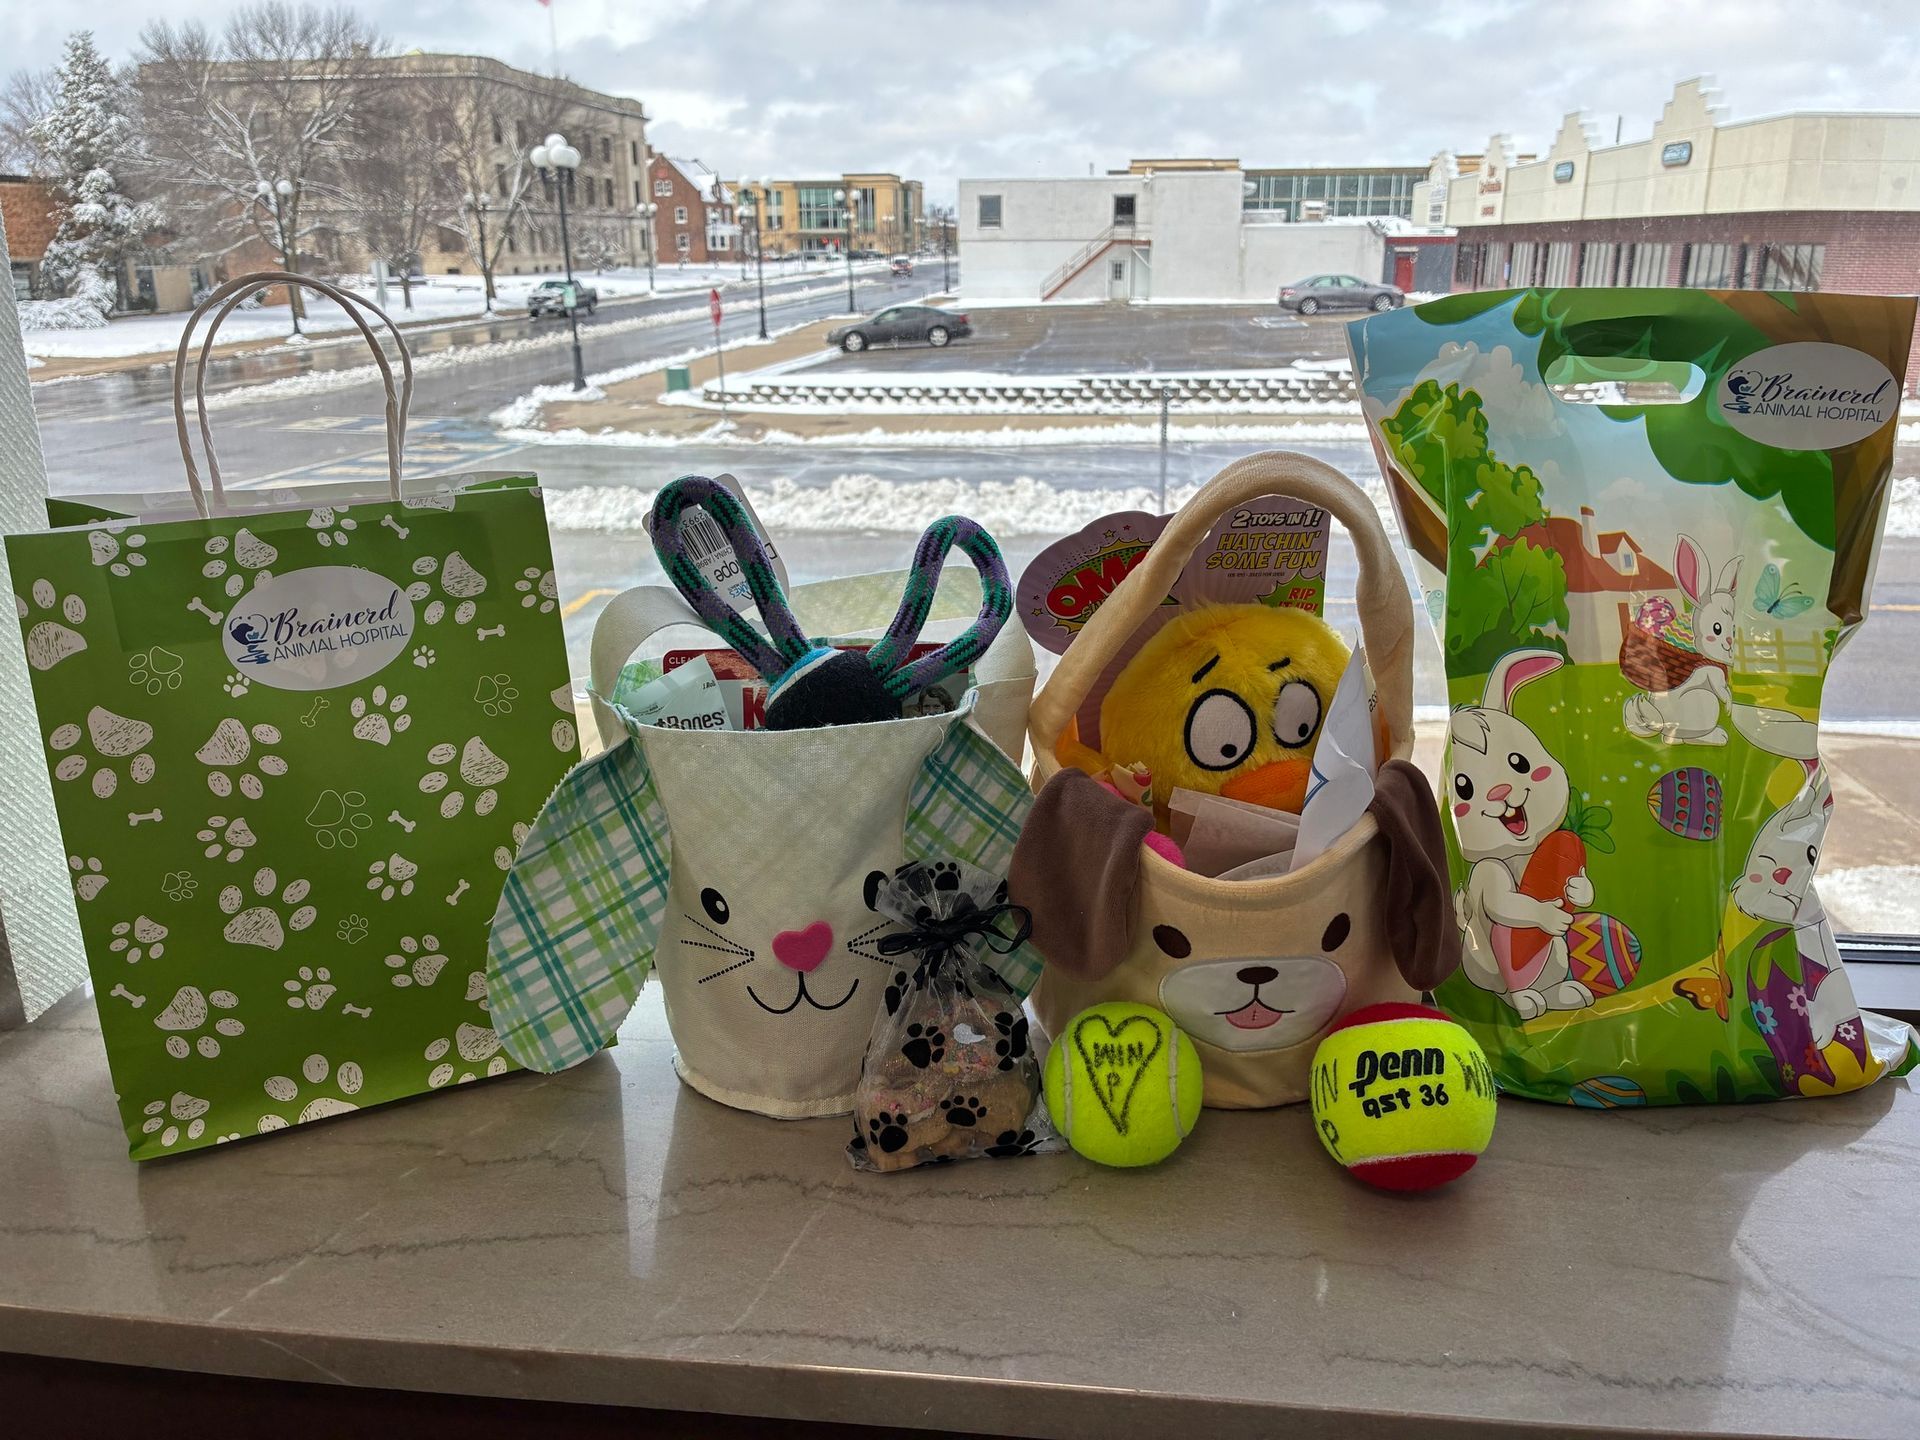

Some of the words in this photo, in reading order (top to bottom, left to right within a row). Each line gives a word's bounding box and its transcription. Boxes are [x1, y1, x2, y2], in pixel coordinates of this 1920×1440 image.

[1761, 373, 1892, 406] Brainerd
[1753, 402, 1813, 418] ANIMAL
[1817, 406, 1883, 423] HOSPITAL
[1231, 509, 1252, 529] 2
[1250, 512, 1286, 527] TOYS
[1286, 511, 1303, 526] IN
[1303, 508, 1323, 528] 1!
[1217, 530, 1323, 551] HATCHIN'
[1206, 551, 1272, 570] SOME
[1274, 550, 1321, 570] FUN
[1288, 587, 1316, 600] RIP
[270, 589, 399, 646] Brainerd
[273, 637, 338, 661] ANIMAL
[340, 623, 408, 649] HOSPITAL
[1093, 1041, 1144, 1068] WIN
[1106, 1072, 1121, 1102] P
[1419, 1083, 1449, 1107] 36
